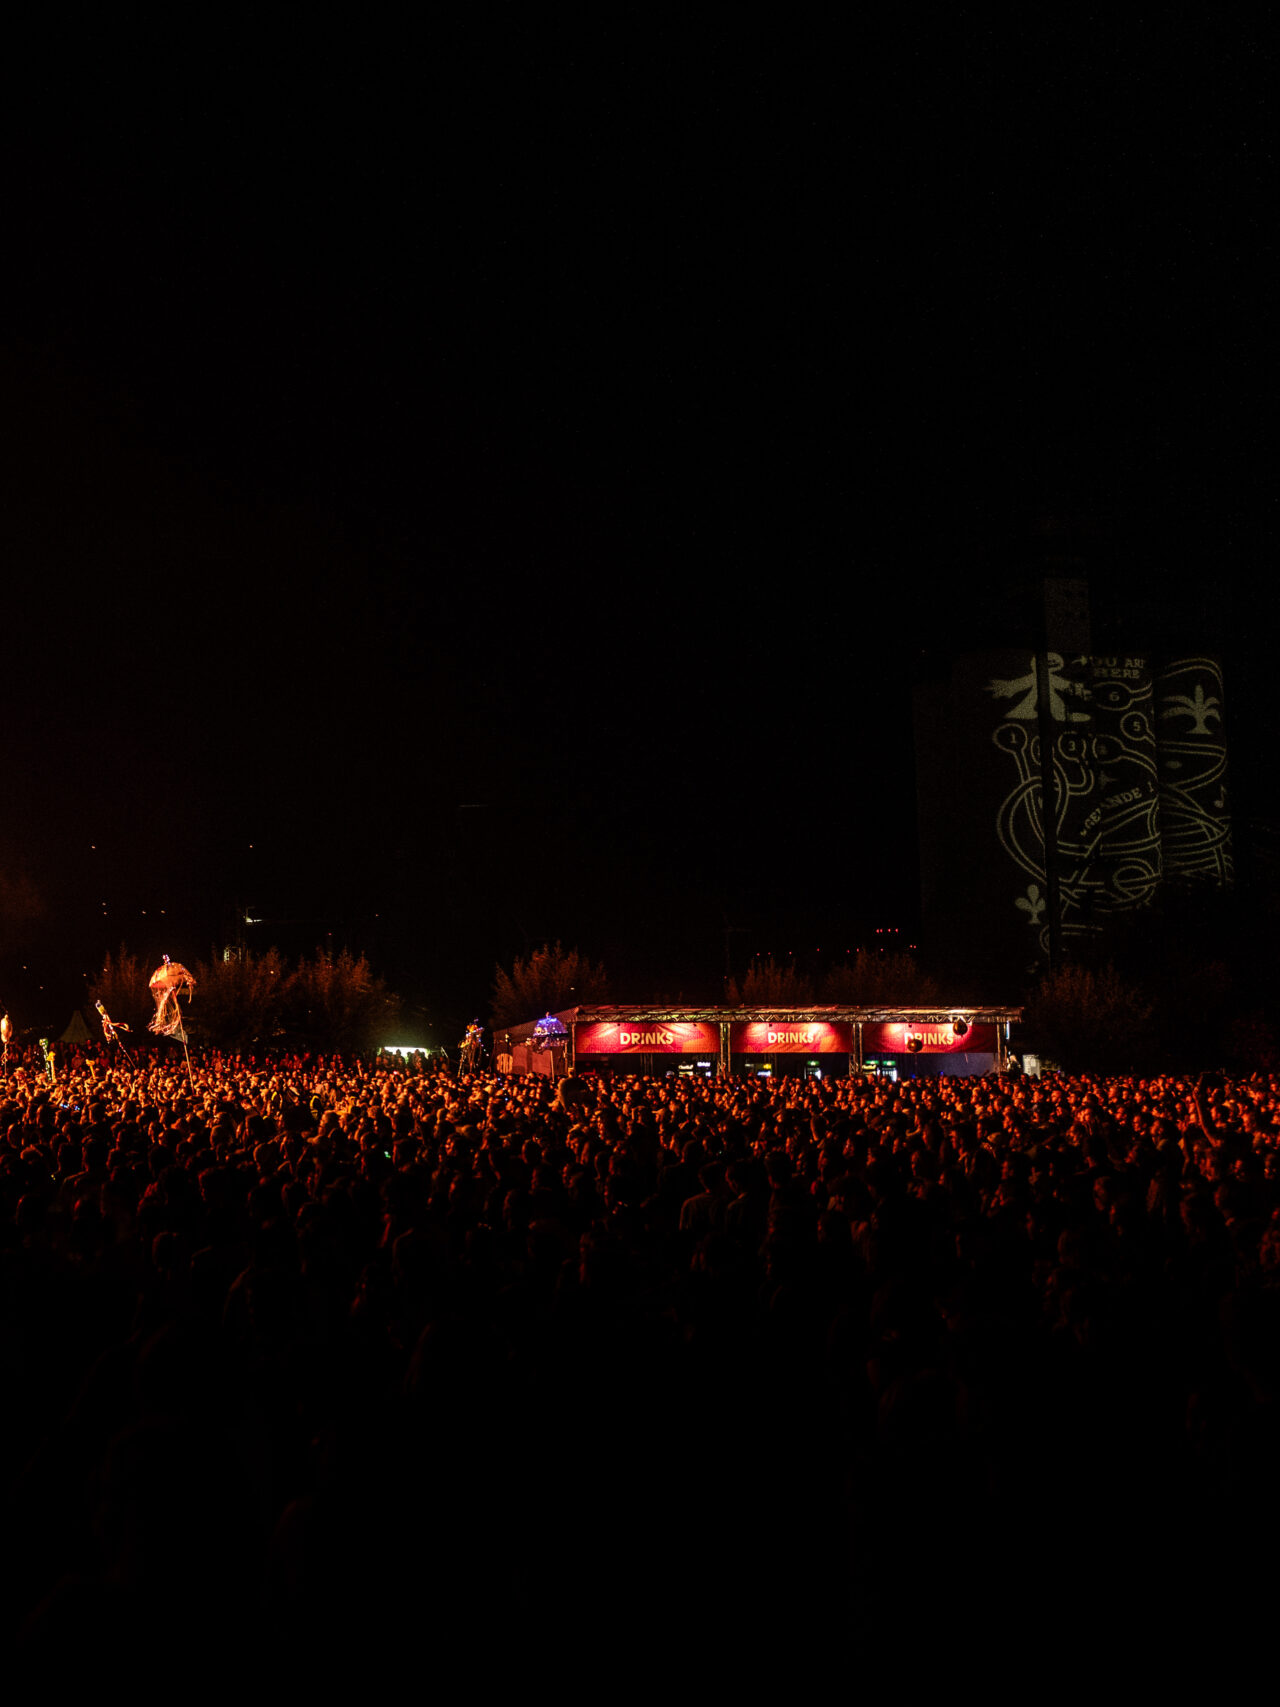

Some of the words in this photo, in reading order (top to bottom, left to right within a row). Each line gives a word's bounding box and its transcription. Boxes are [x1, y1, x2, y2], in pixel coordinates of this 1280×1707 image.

[1132, 721, 1141, 732] 5
[1010, 732, 1017, 744] 1
[1068, 740, 1076, 751] 3
[620, 1032, 674, 1045] DRINKS
[768, 1032, 814, 1044] DRINKS
